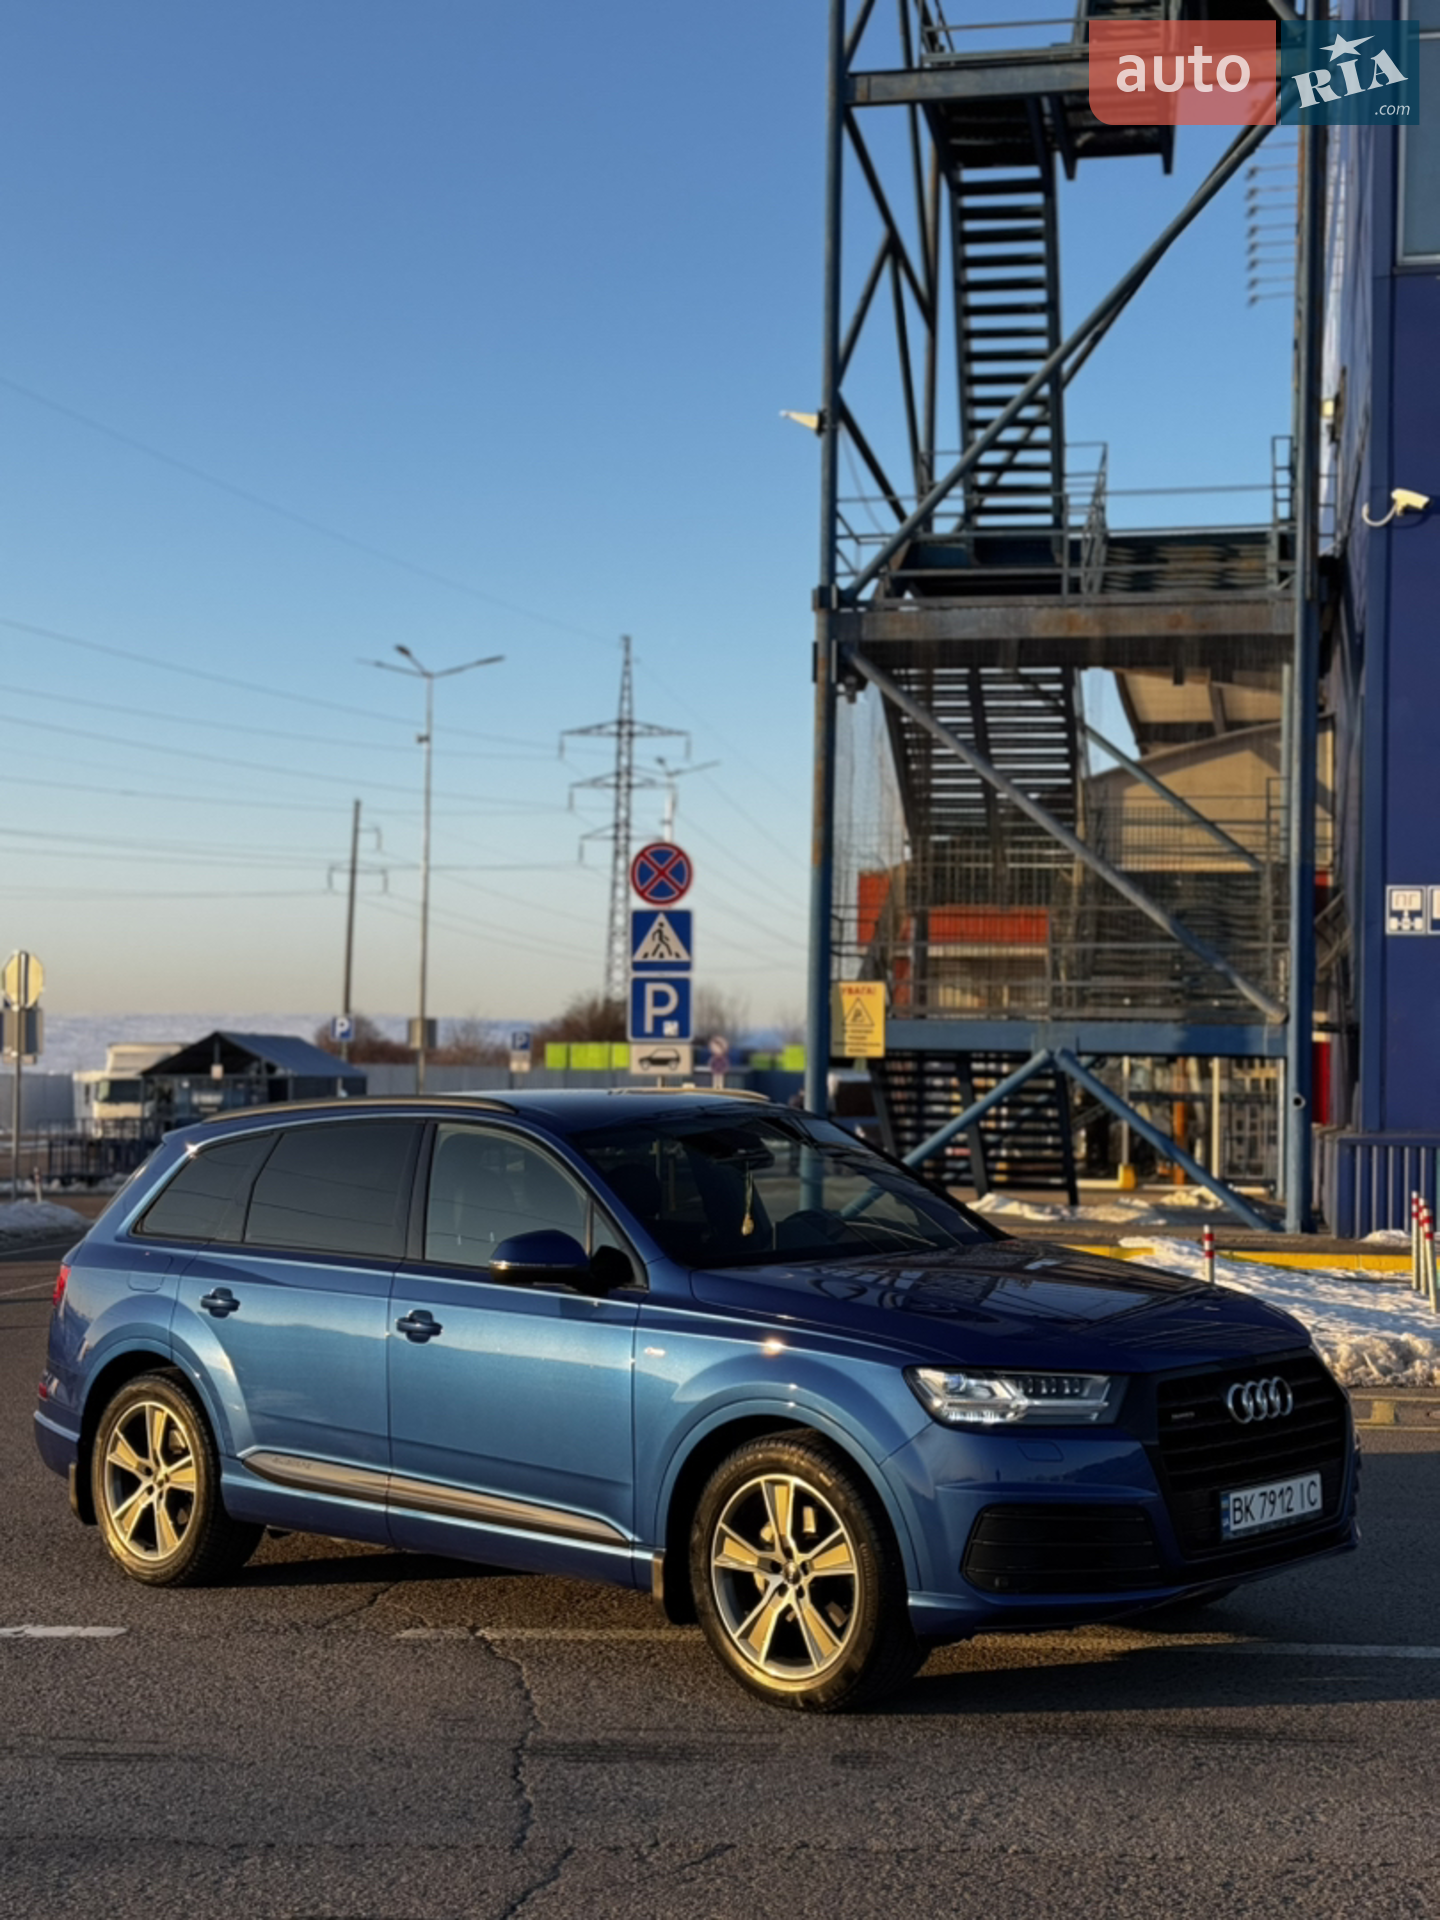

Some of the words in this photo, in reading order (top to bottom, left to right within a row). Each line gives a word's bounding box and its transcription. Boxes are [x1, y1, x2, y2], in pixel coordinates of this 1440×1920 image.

[644, 982, 679, 1034] P
[335, 1018, 350, 1039] P
[1232, 1493, 1255, 1525] BK
[1259, 1485, 1294, 1519] 7912
